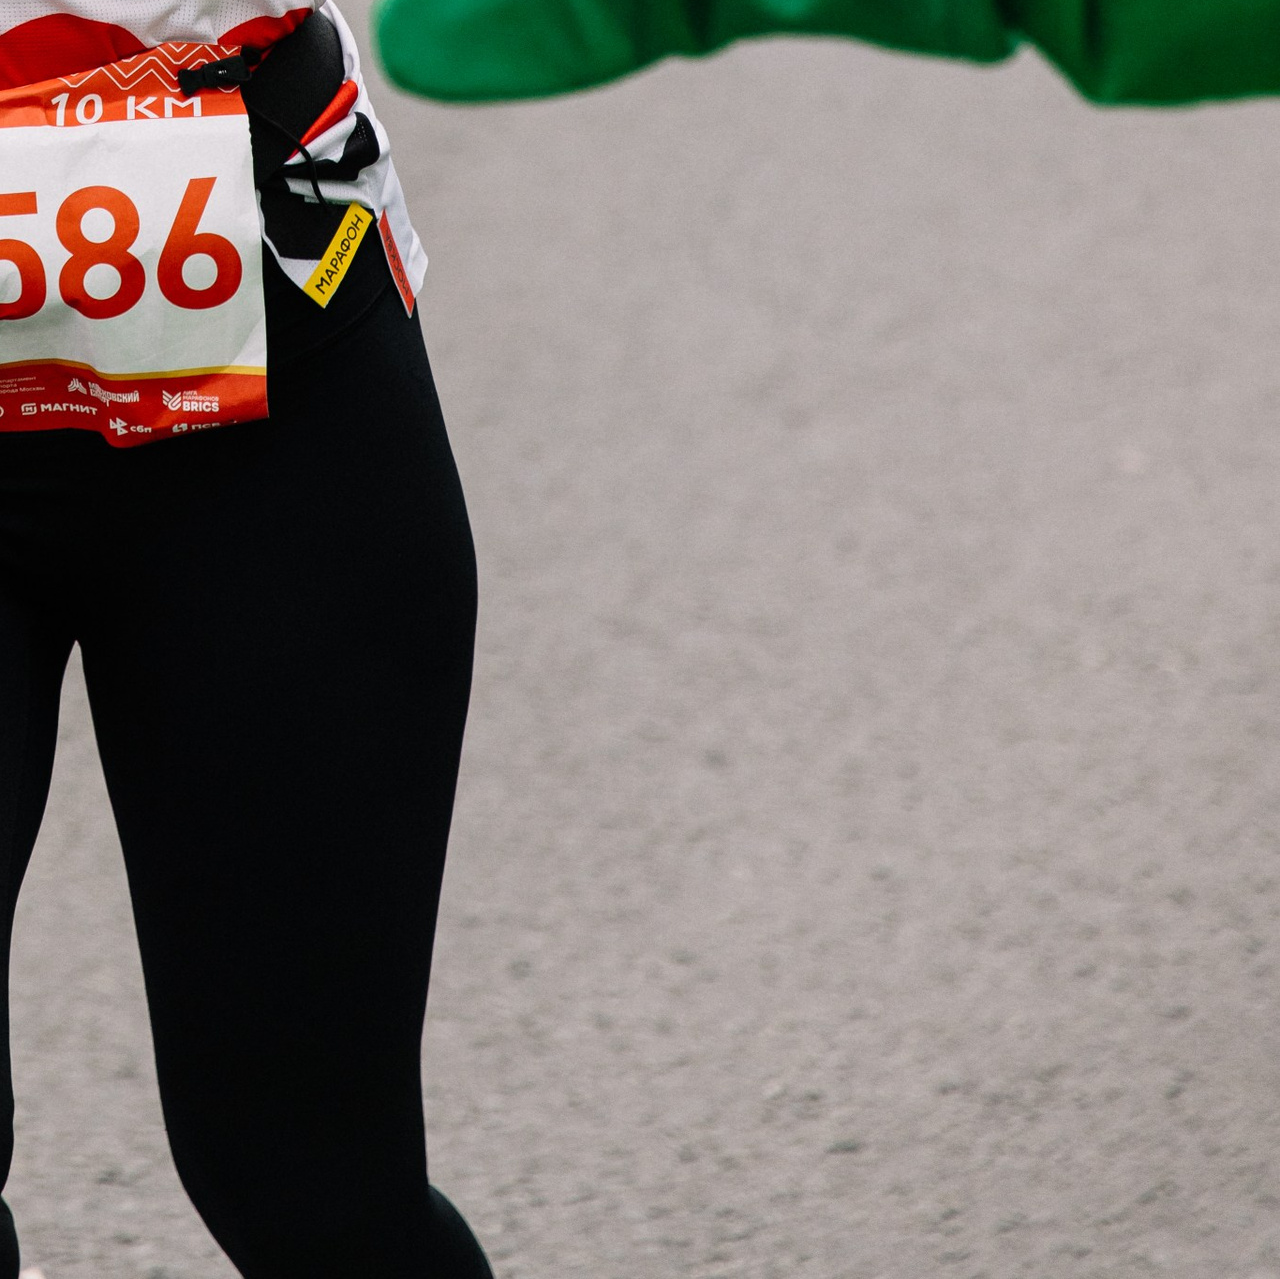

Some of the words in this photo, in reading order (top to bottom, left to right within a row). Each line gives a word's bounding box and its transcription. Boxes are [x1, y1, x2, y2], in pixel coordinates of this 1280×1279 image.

[50, 92, 103, 127] 10
[315, 213, 364, 295] МАРАФОН
[40, 402, 98, 416] МАГНИТ
[182, 401, 220, 412] BRICS
